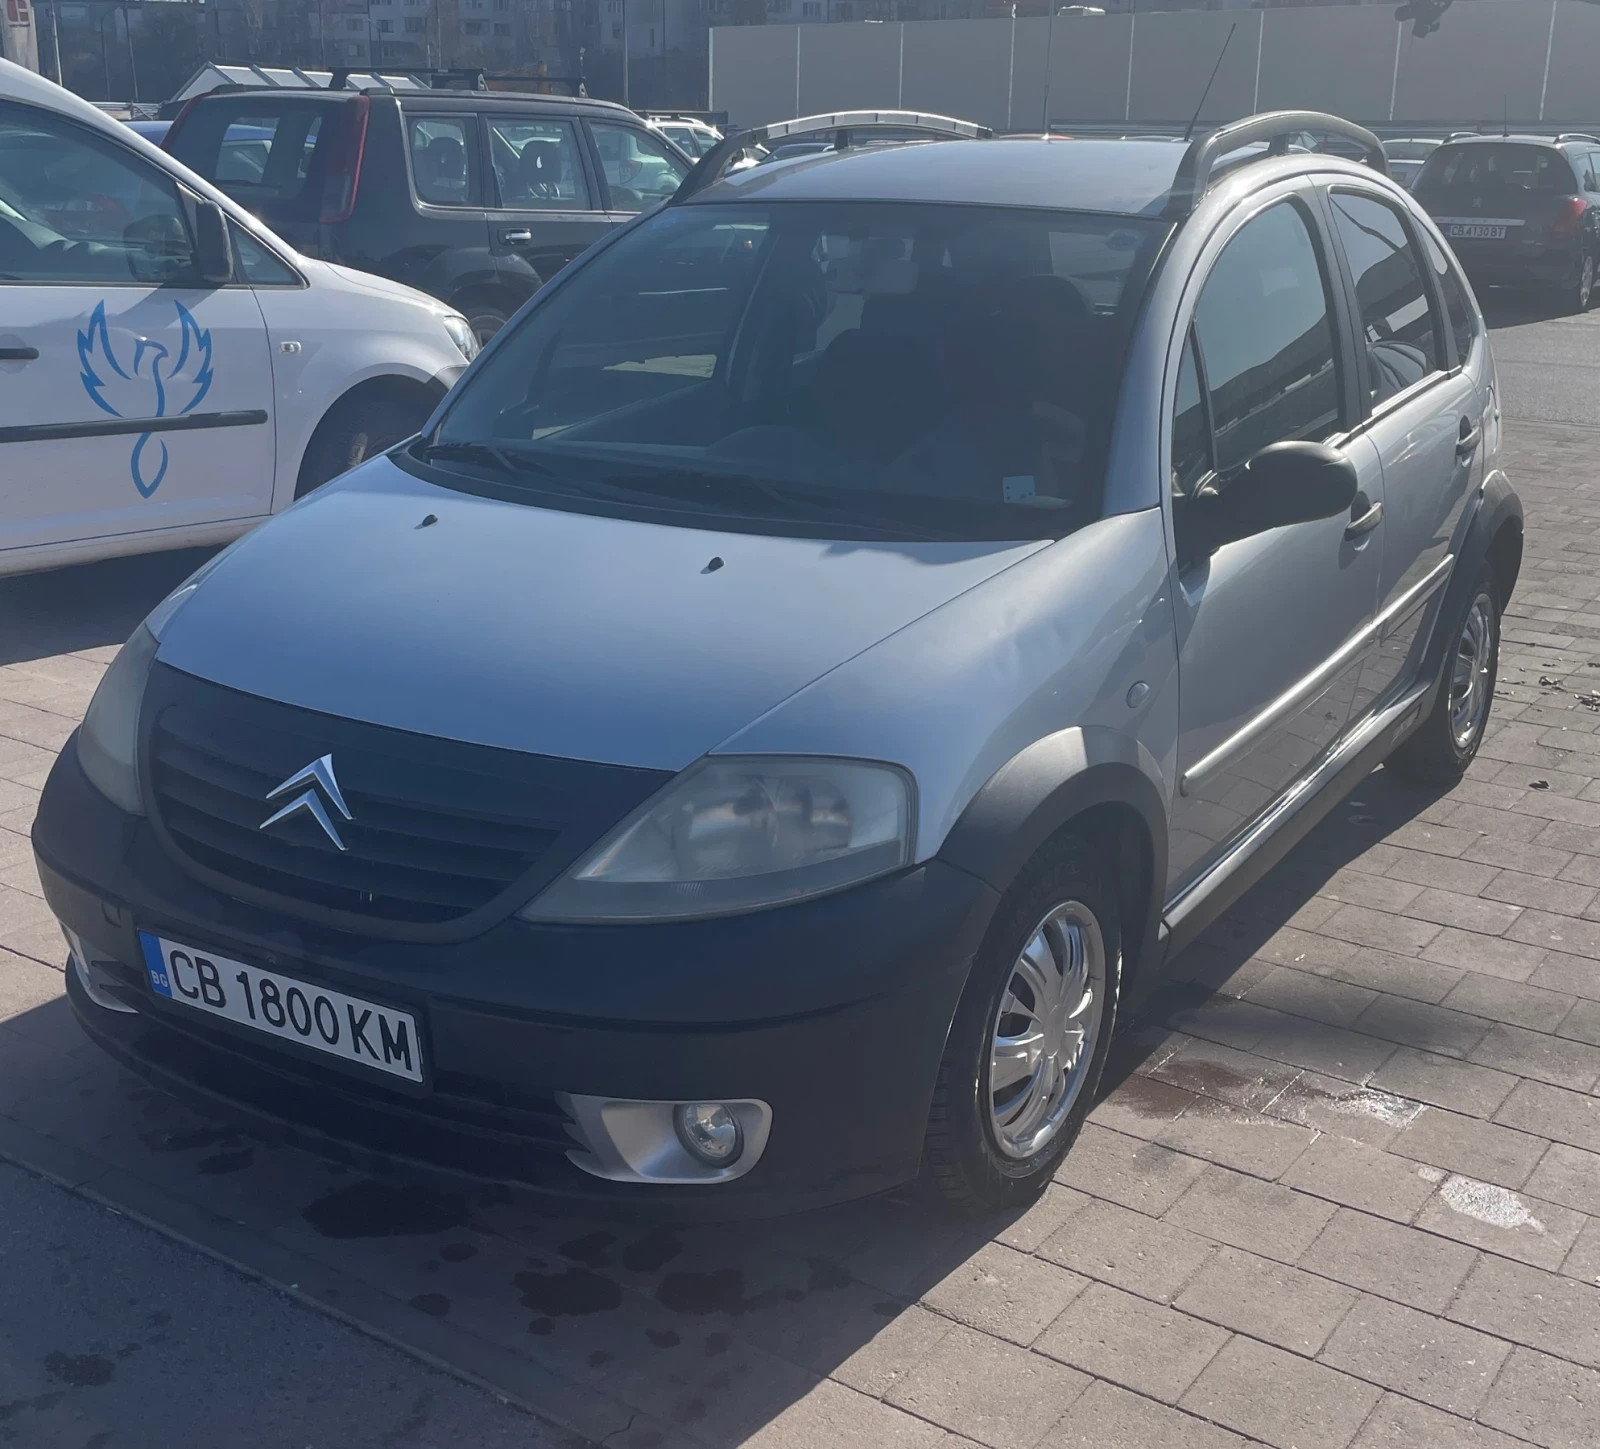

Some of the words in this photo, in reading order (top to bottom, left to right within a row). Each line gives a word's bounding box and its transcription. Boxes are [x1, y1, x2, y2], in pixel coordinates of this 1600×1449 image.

[1451, 224, 1465, 236] CB
[151, 970, 169, 988] BG
[170, 950, 226, 1008] CB
